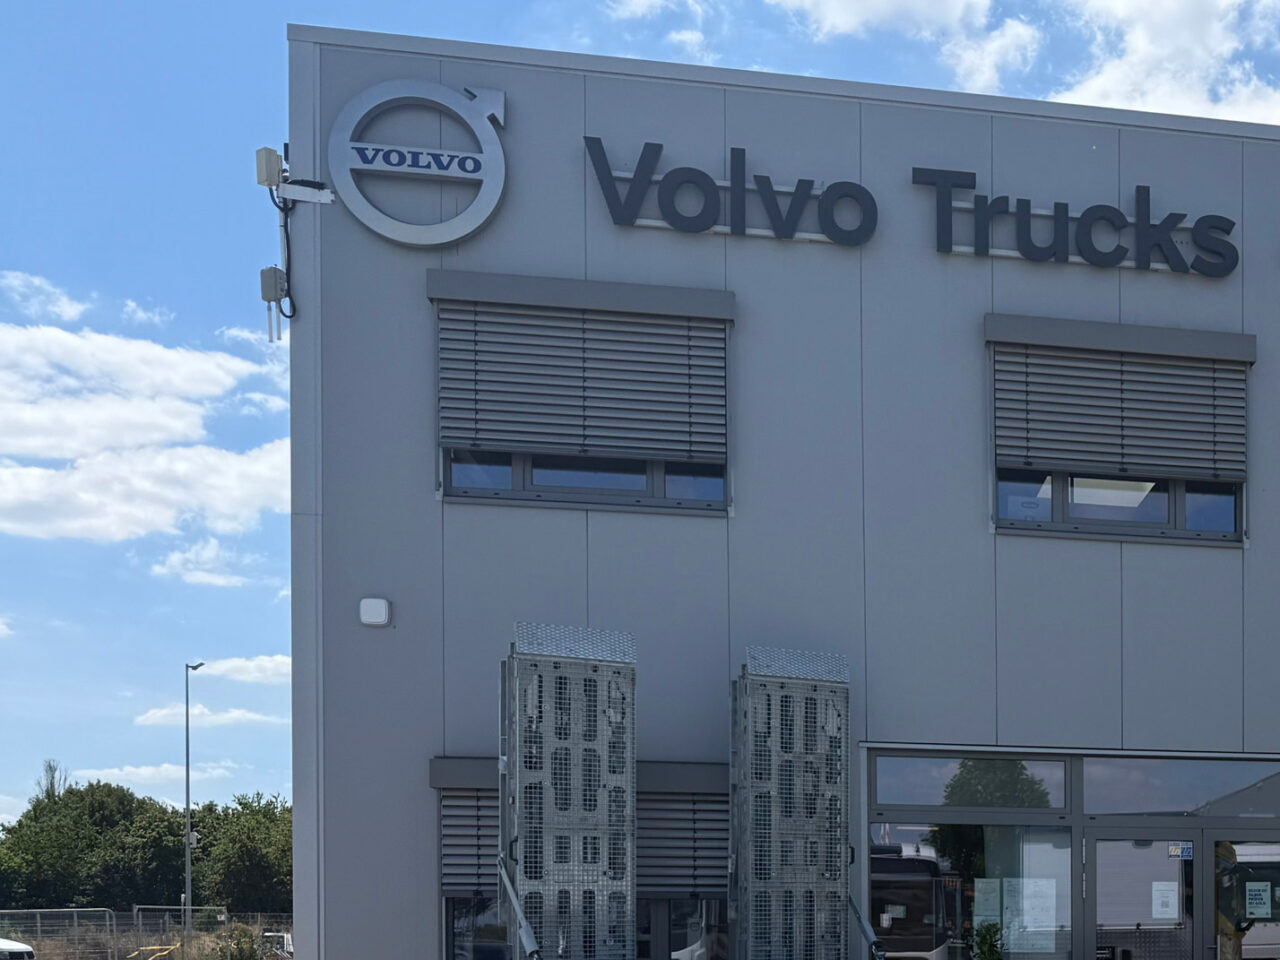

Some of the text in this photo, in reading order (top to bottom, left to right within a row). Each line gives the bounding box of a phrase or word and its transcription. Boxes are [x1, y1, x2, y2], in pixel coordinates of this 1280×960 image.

[351, 147, 482, 174] VOLVO
[583, 136, 1239, 277] Volvo Trucks
